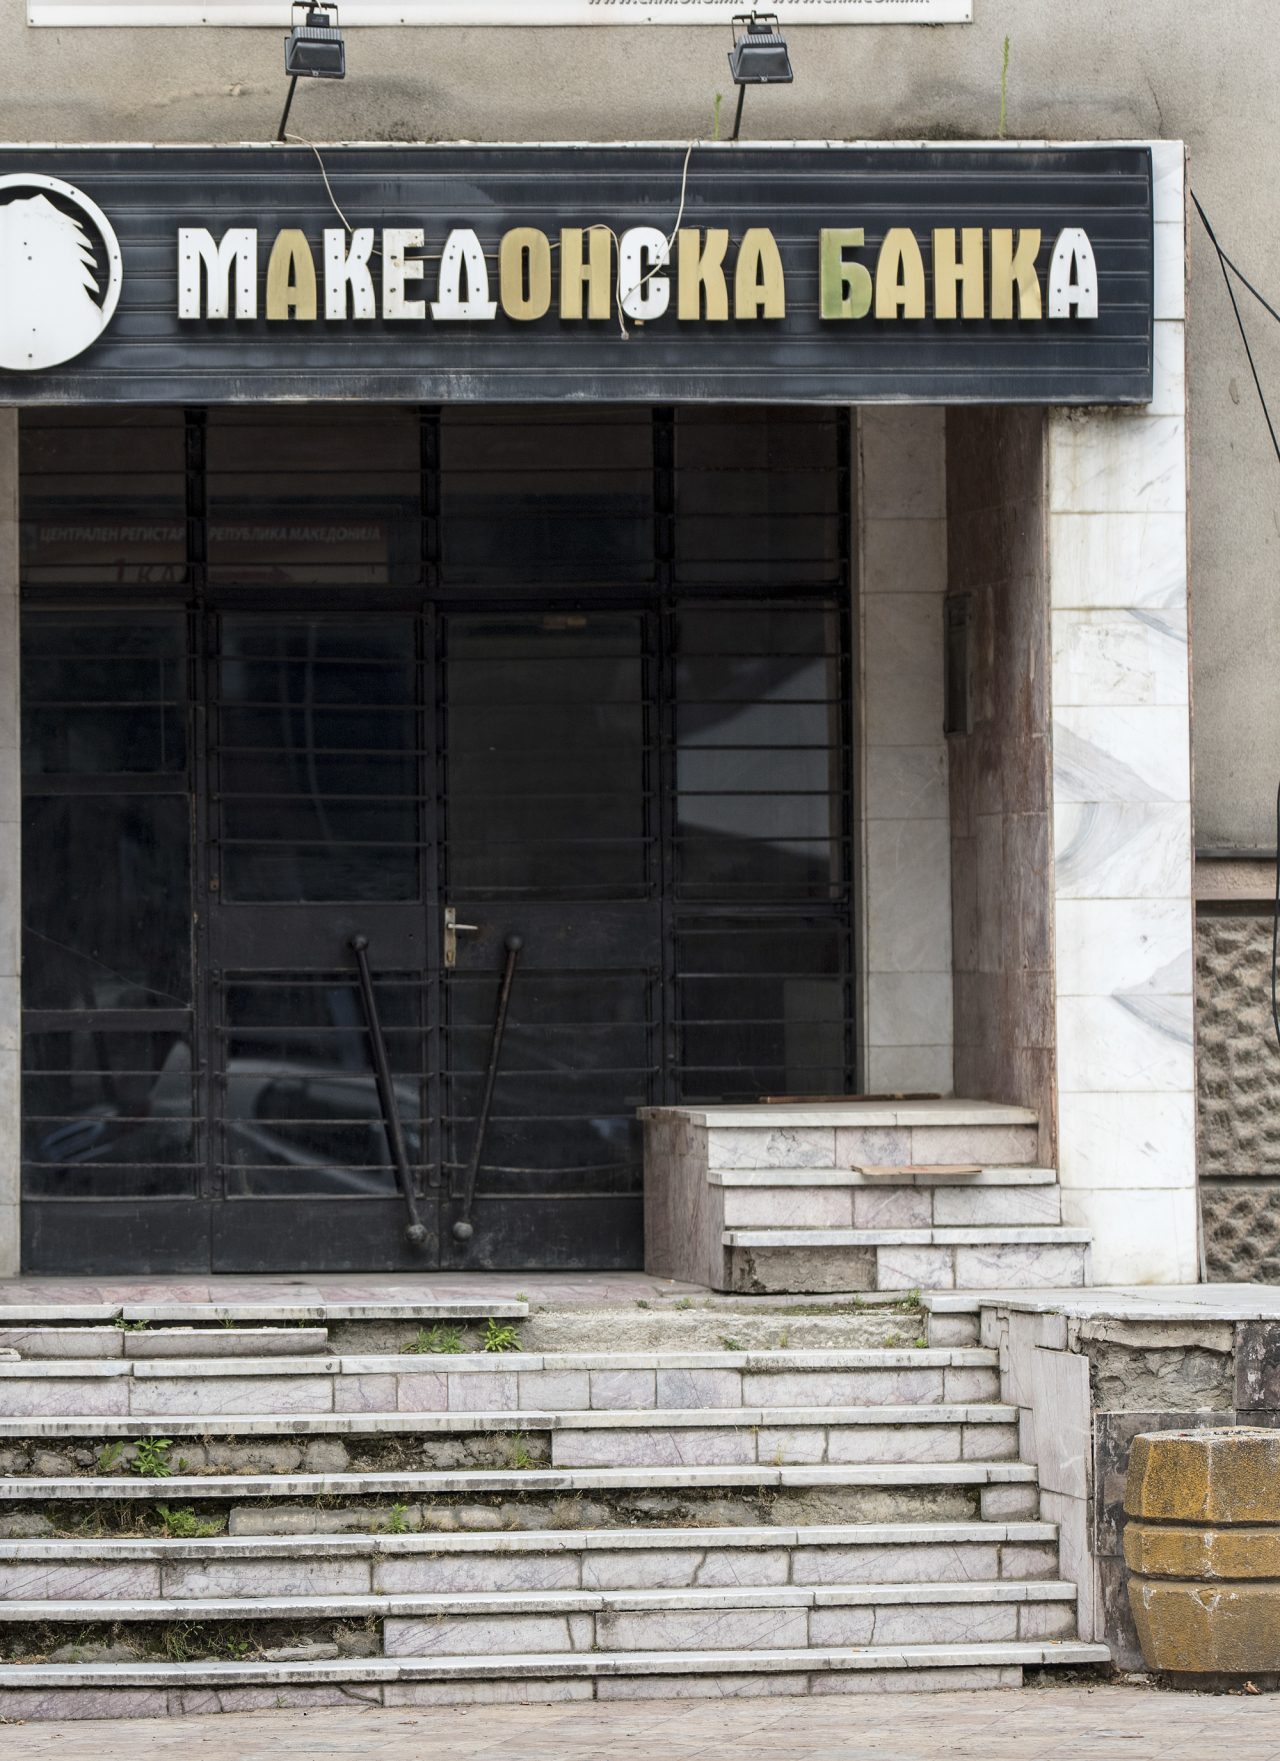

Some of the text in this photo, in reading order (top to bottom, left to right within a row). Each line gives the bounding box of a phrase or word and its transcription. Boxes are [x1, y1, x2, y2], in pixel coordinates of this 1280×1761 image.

[177, 226, 1099, 321] МАКЕДОНСКА БАНКА
[40, 526, 381, 544] ЦЕНТРАЛЕН РЕГИСТАР РЕПУБЛИКА МАКЕДОНИЈА
